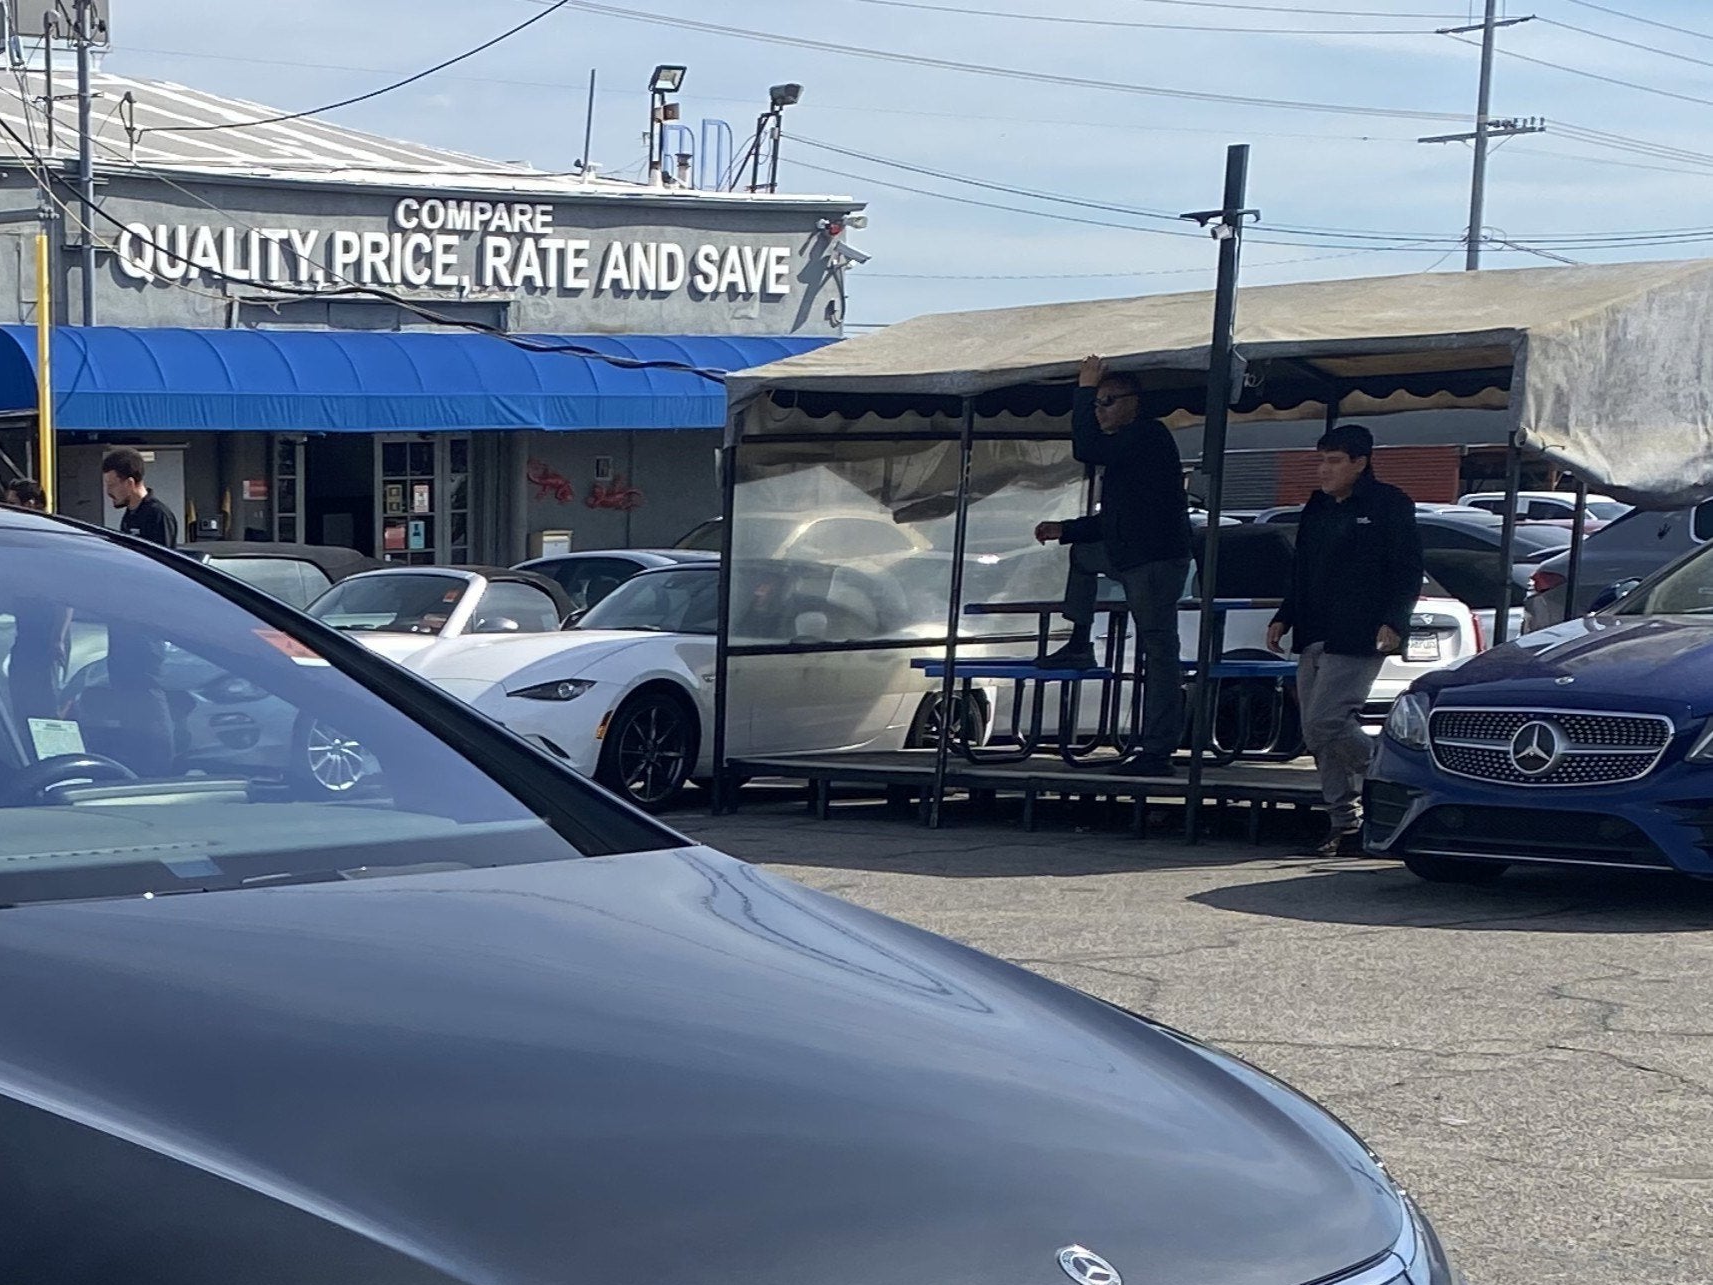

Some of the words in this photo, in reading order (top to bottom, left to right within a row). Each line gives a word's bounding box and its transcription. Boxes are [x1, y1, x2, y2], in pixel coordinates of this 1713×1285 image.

[395, 197, 554, 234] COMPARE
[332, 229, 471, 299] PRICE,
[483, 236, 590, 288] RATE
[601, 240, 685, 291] AND
[693, 243, 791, 294] SAVE
